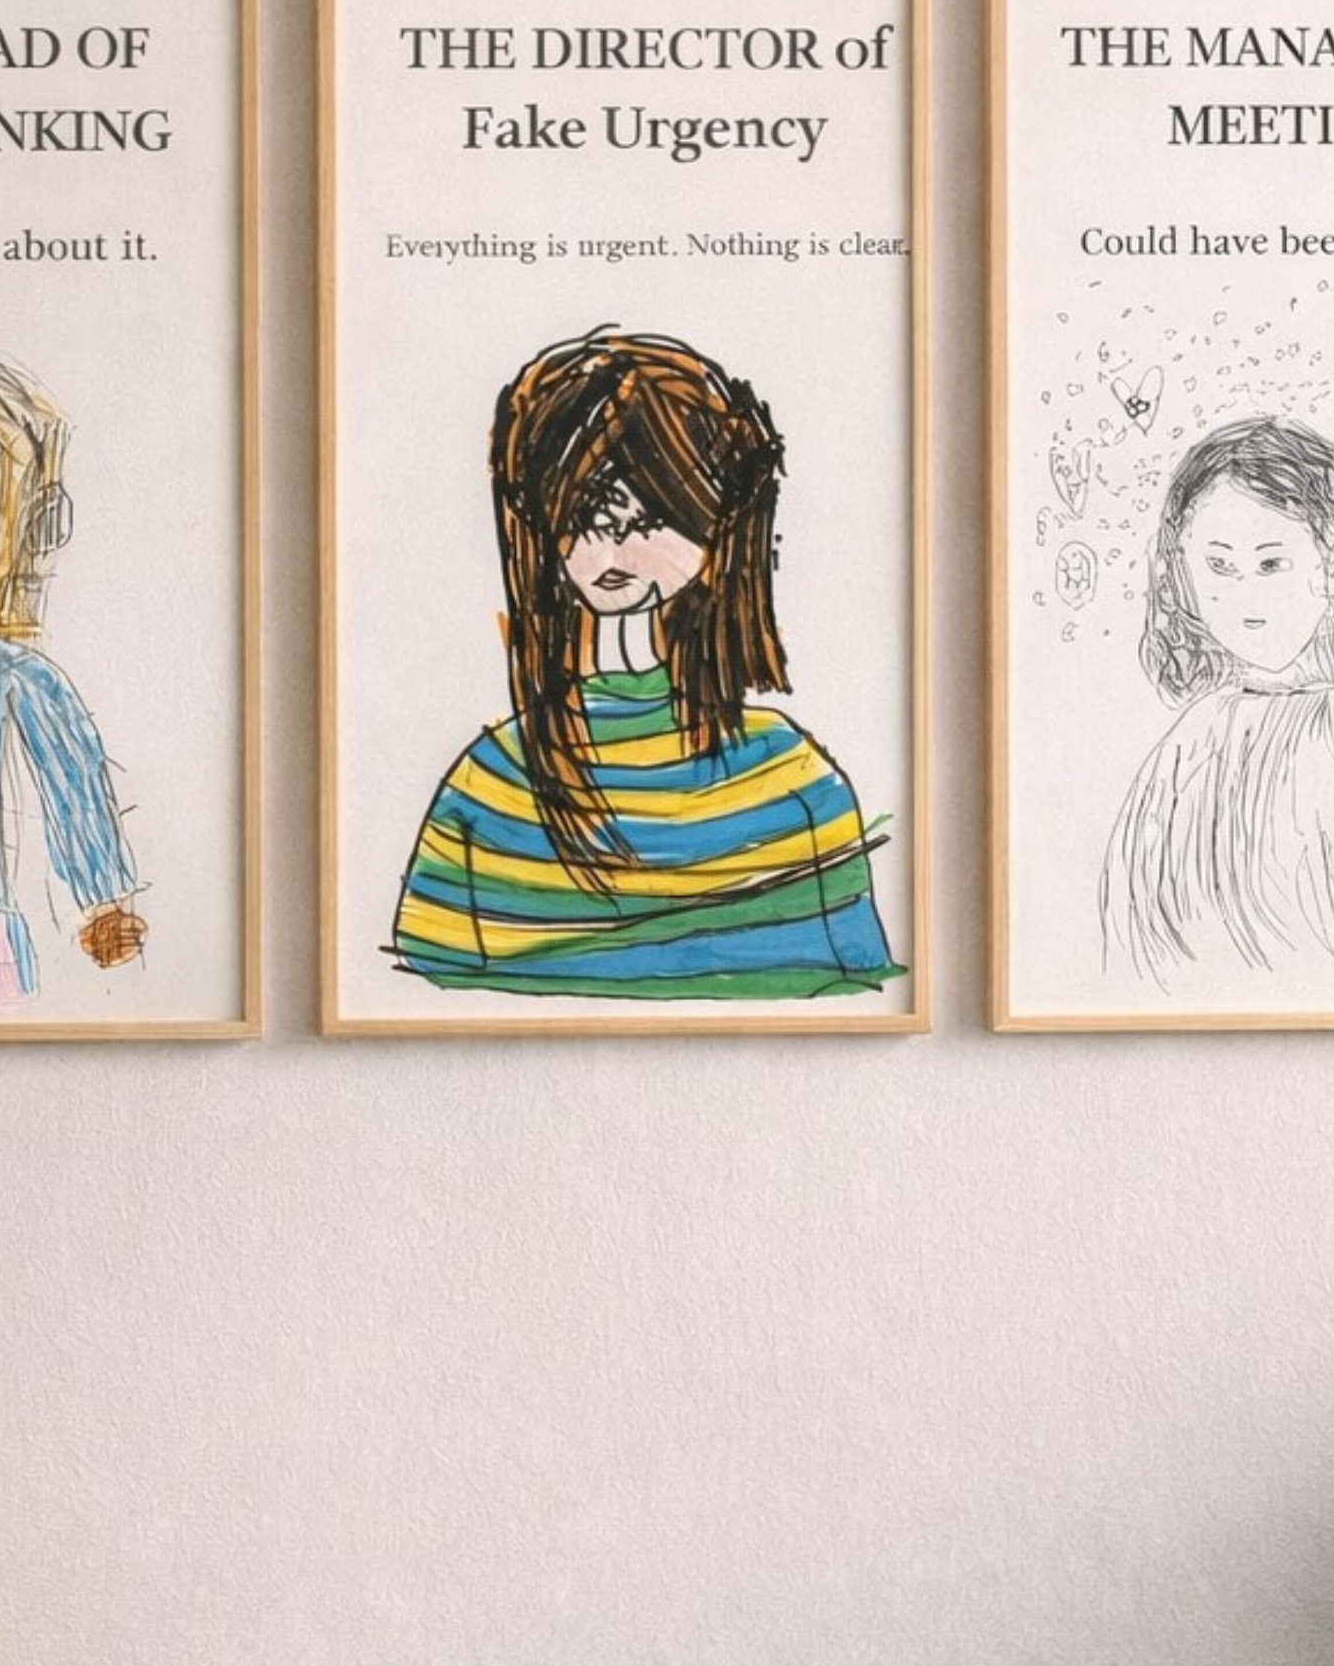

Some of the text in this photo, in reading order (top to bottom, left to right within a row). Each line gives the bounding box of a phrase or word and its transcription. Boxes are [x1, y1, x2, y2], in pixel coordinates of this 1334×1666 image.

[77, 26, 151, 70] OF
[400, 22, 895, 71] THE DIRECTOR of
[1060, 26, 1173, 69] THE
[463, 104, 830, 165] Fake Urgency
[3, 229, 109, 263] about
[122, 230, 159, 263] it.
[547, 233, 570, 259] is
[578, 234, 680, 265] urgent.
[687, 231, 802, 265] Nothing
[809, 232, 831, 257] is
[840, 231, 912, 257] clear.
[1080, 225, 1178, 257] Could
[1191, 225, 1270, 257] have
